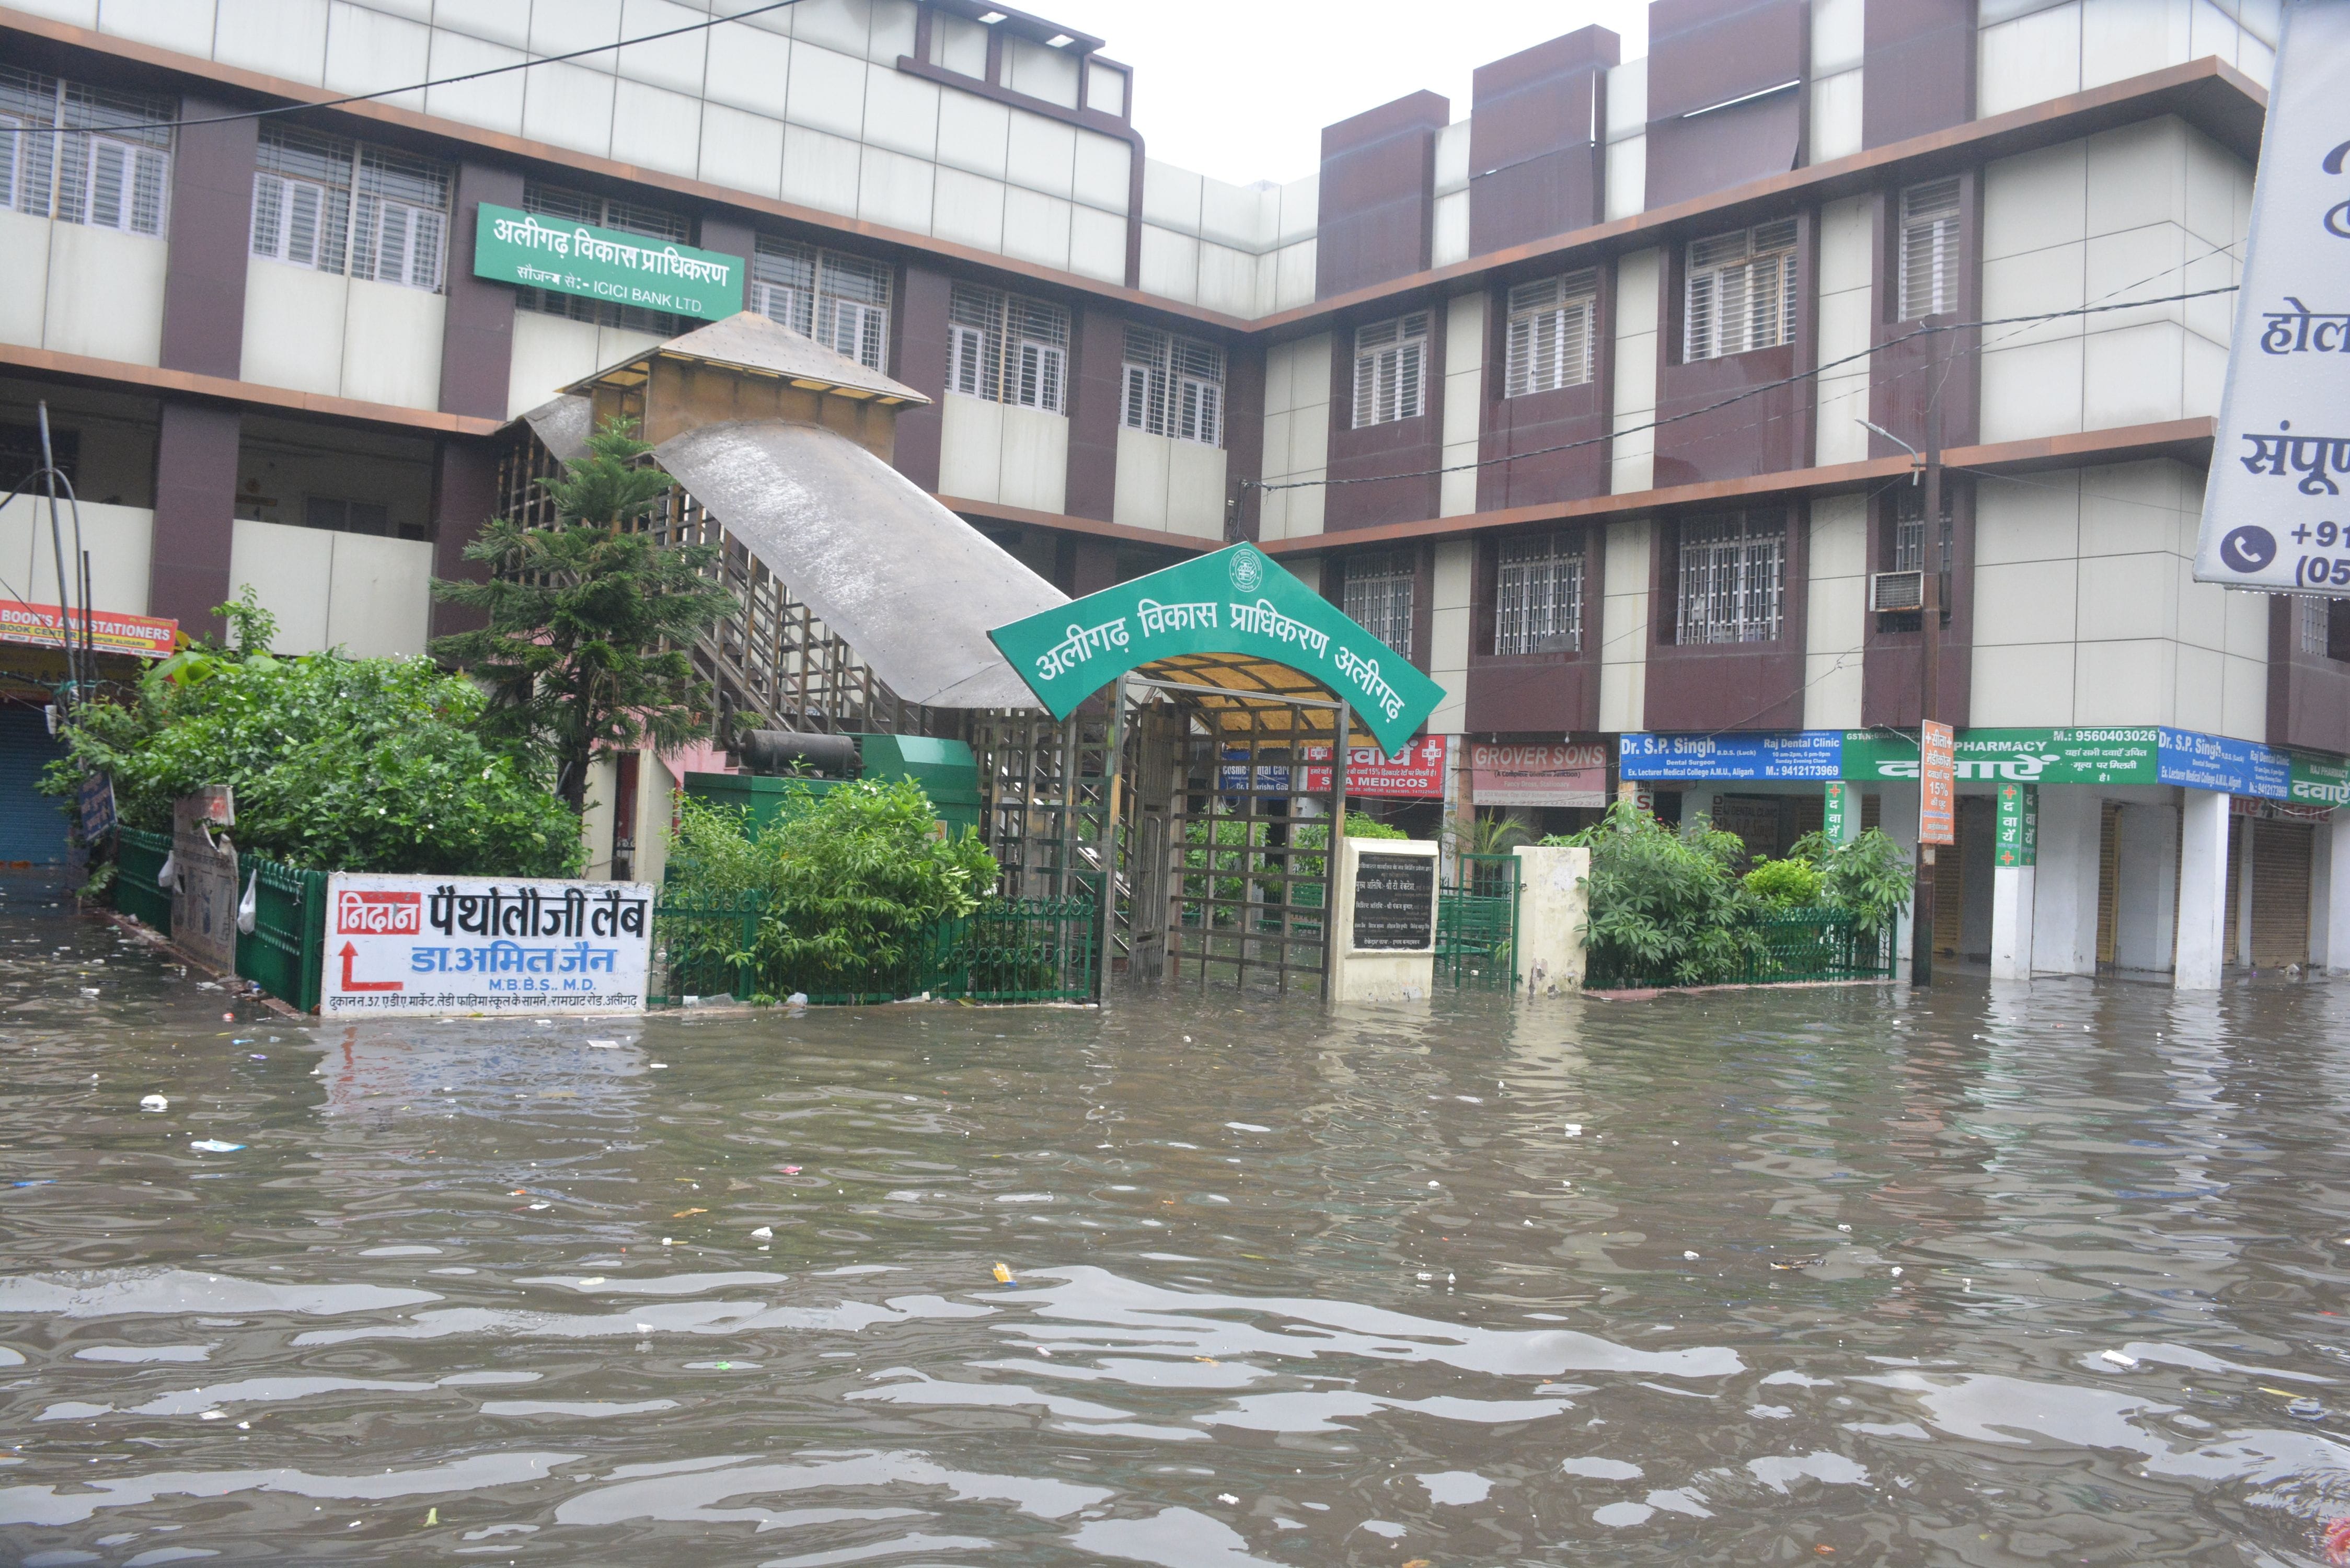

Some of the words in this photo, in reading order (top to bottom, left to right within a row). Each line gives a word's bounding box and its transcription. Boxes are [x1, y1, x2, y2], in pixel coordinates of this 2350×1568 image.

[494, 216, 571, 259] अलीगढ़
[574, 228, 638, 269] विकास
[642, 246, 729, 286] प्राधिकरण
[594, 281, 627, 298] ICICI
[632, 289, 671, 307] BANK
[675, 296, 705, 314] LTD.
[2, 609, 53, 627] BOOK'S
[91, 619, 170, 641] STATIONERS
[34, 628, 76, 639] CENTR
[1035, 617, 1129, 680] अलीगढ़
[1137, 598, 1217, 638] विकास
[1229, 598, 1330, 659] प्राधिकरण
[1335, 647, 1405, 723] अलीगढ़
[2054, 731, 2071, 741] M.:
[2076, 730, 2156, 741] 9560403026
[1621, 739, 1640, 755] Dr.
[1644, 737, 1669, 754] S.P.
[1674, 737, 1715, 757] Singh
[1764, 739, 1779, 750] Raj
[1781, 738, 1810, 747] Dental
[1813, 737, 1840, 747] Clinic
[1953, 741, 2047, 752] PHARMACY
[2158, 731, 2172, 749] Dr.
[2175, 734, 2192, 753] S.P.
[2195, 738, 2221, 760] Singh
[1476, 747, 1548, 765] GROVER
[1553, 746, 1604, 765] SONS
[2082, 747, 2100, 757] सभी
[2125, 747, 2147, 756] उचित
[1687, 768, 1708, 777] College
[1732, 768, 1754, 777] Aligarh
[1766, 766, 1779, 776] M.:
[1781, 765, 1838, 776] 9412173969
[2073, 762, 2092, 771] मूल्य
[2110, 760, 2137, 769] मिलती
[2310, 765, 2320, 775] RAJ
[2321, 766, 2348, 779] PHARMACY
[1321, 777, 1353, 785] SA
[1359, 777, 1427, 787] MEDICOS
[2098, 773, 2110, 782] है।
[1929, 781, 1948, 797] 15%
[340, 892, 419, 933] निदान
[592, 889, 648, 939] लैब
[559, 941, 618, 973] जैन
[563, 978, 597, 991] M.D.
[329, 995, 356, 1010] दुकान
[511, 993, 521, 1007] के
